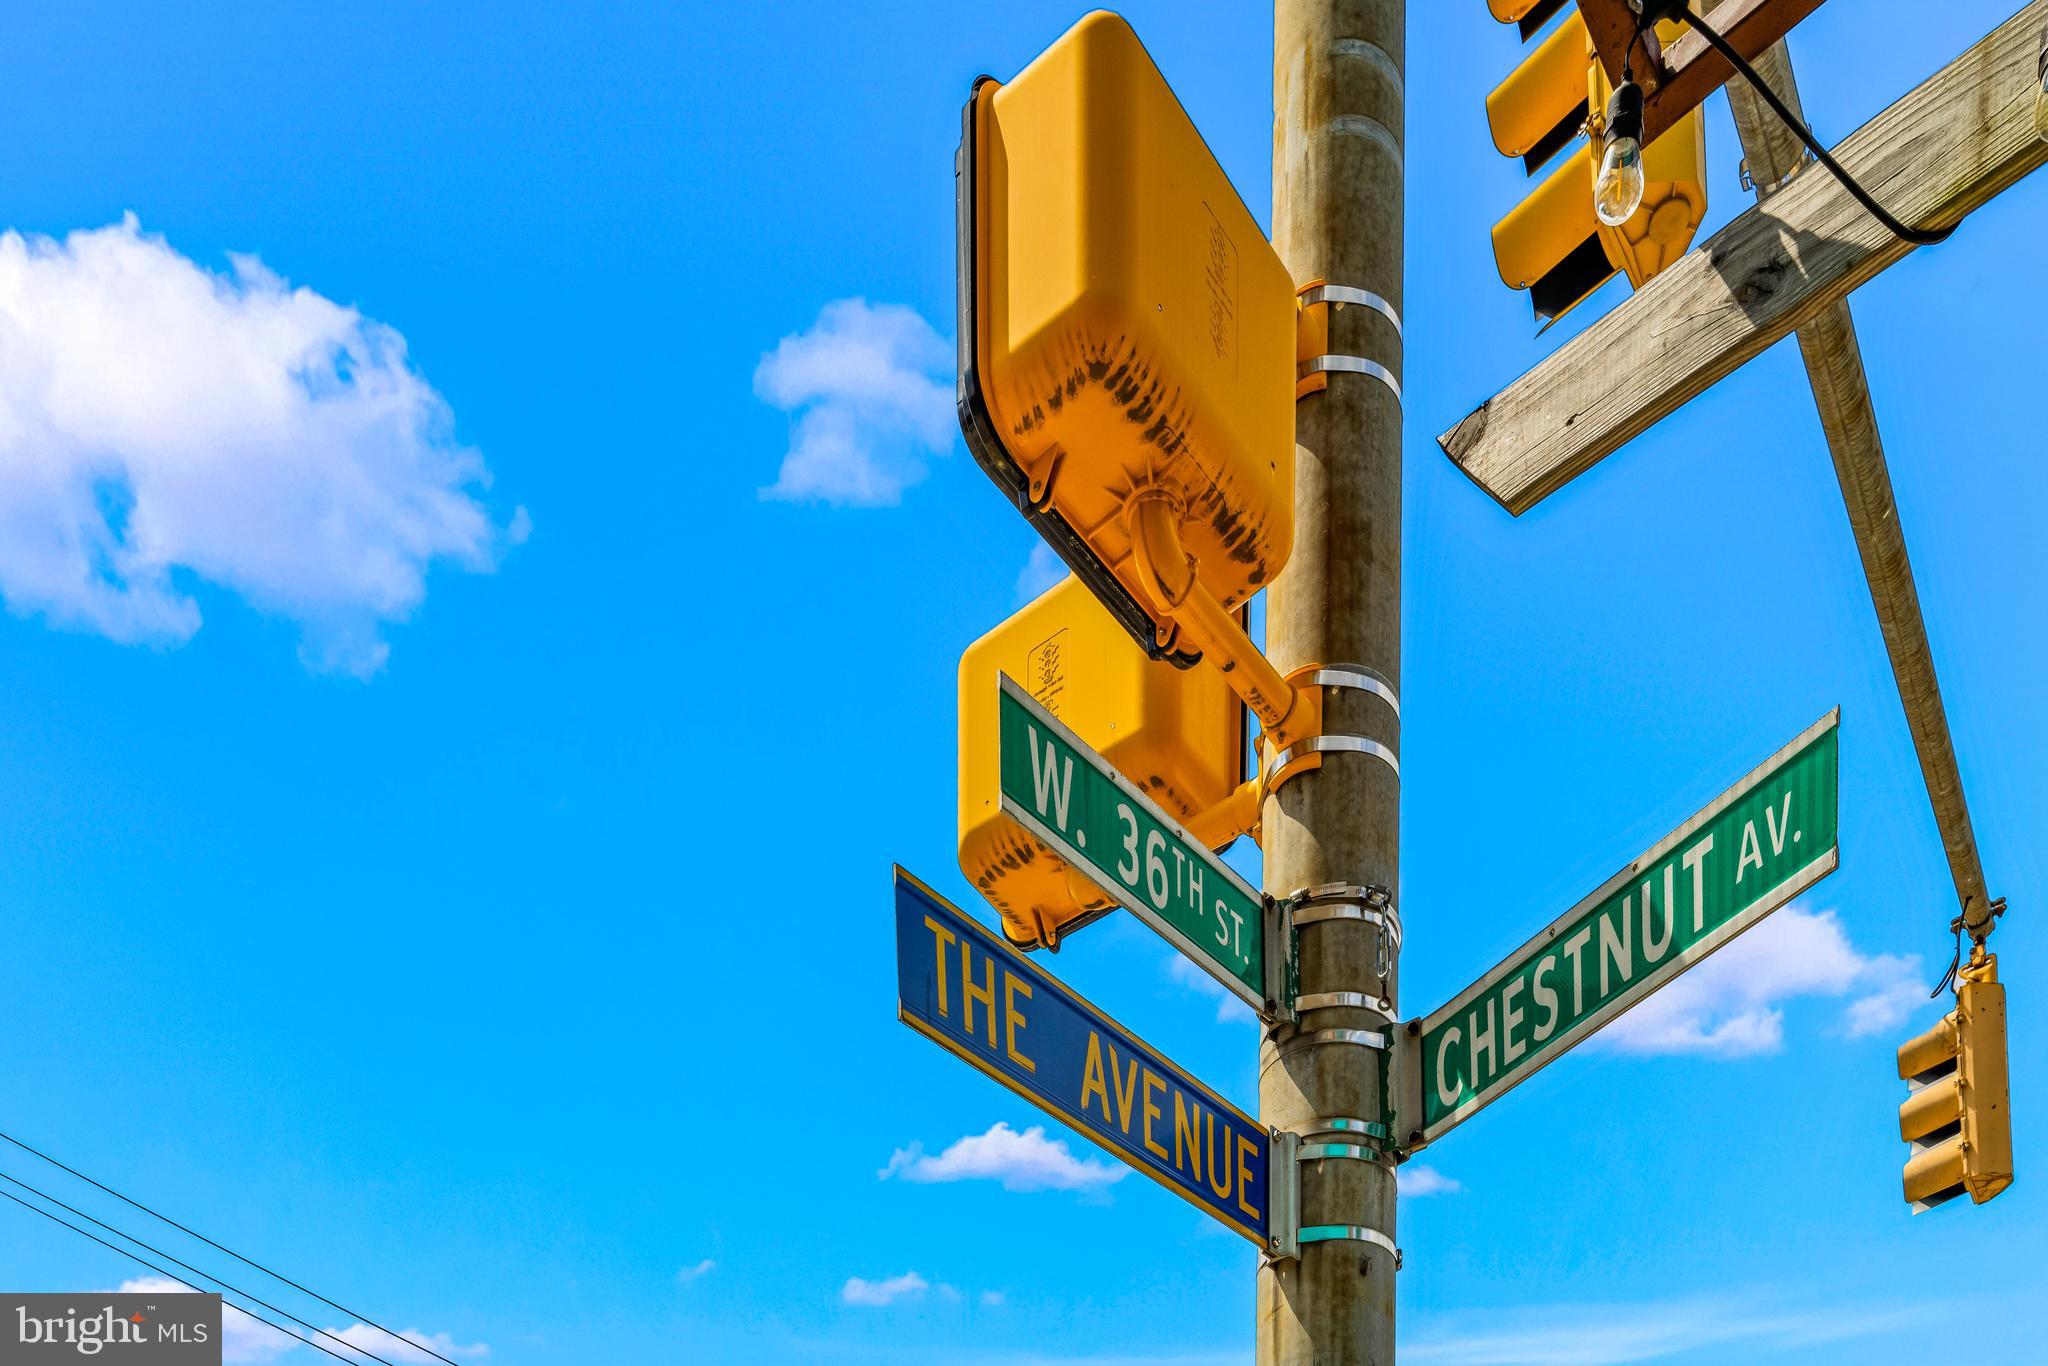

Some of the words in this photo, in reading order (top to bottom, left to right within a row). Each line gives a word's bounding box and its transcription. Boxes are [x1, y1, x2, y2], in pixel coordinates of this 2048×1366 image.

[1028, 724, 1086, 848] W.
[1117, 803, 1203, 916] 36TH
[1215, 899, 1249, 965] ST.
[1436, 833, 1714, 1107] CHESTNUT
[1736, 791, 1802, 884] AV.
[924, 915, 1036, 1073] THE
[1080, 1031, 1260, 1220] AVENUE
